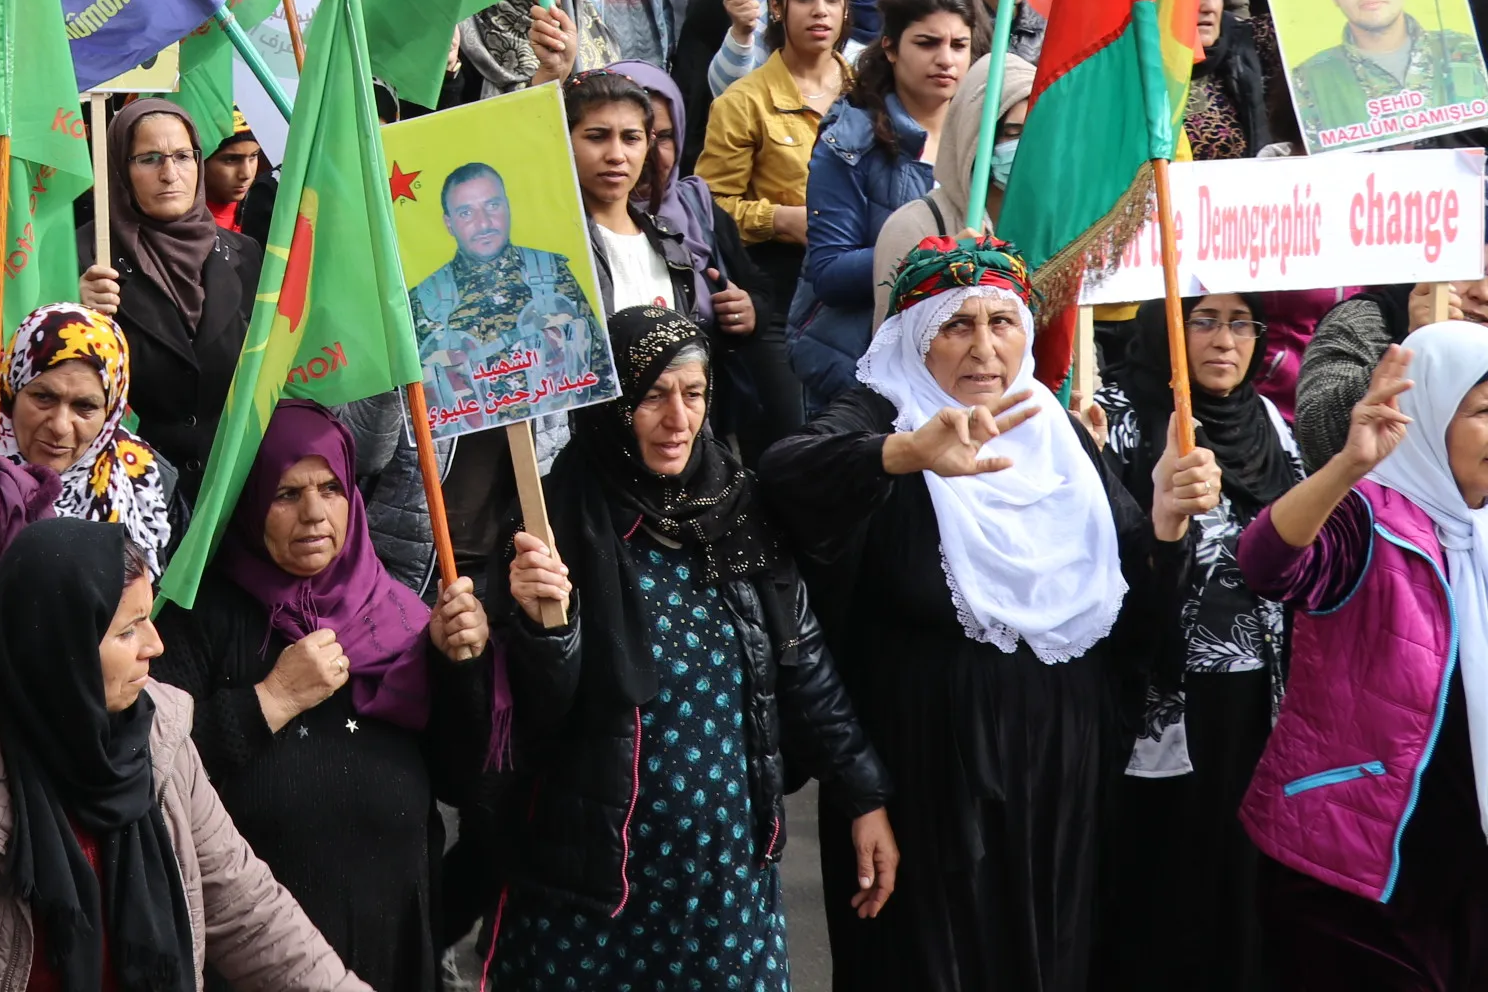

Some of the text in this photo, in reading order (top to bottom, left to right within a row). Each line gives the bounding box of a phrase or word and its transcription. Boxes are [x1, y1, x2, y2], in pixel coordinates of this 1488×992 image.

[1367, 90, 1423, 116] ŞEHÎD
[1319, 99, 1488, 147] MAZLÛM QAMIŞLO
[1197, 182, 1323, 279] Demographic
[1349, 171, 1460, 264] change
[472, 348, 541, 383] الشهيد
[426, 398, 481, 429] عليوي
